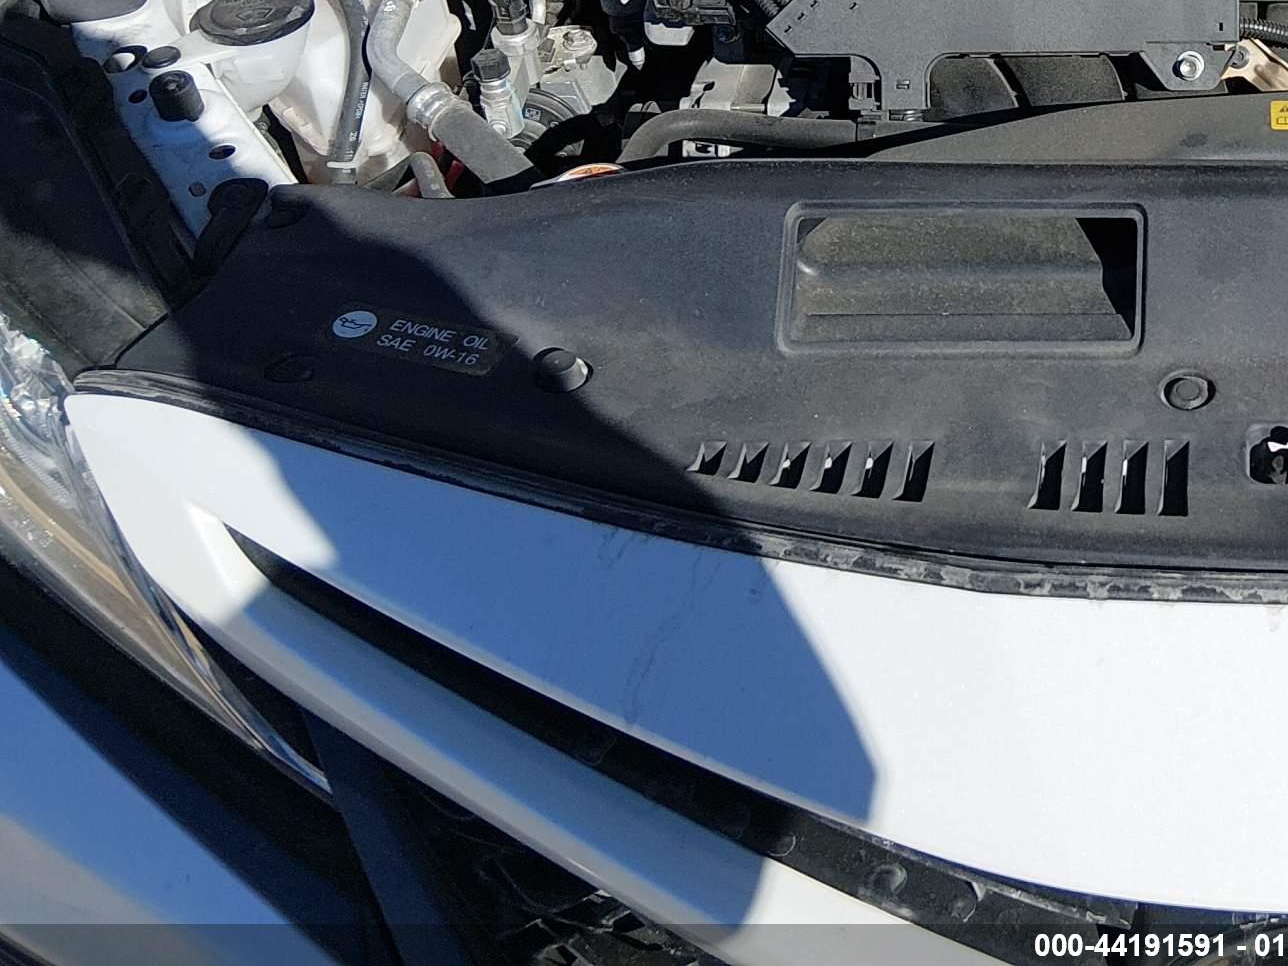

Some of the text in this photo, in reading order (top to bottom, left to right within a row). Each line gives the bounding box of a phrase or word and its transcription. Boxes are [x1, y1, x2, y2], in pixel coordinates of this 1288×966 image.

[377, 334, 479, 365] SAE 0W-16
[391, 319, 488, 350] ENGINE OIL
